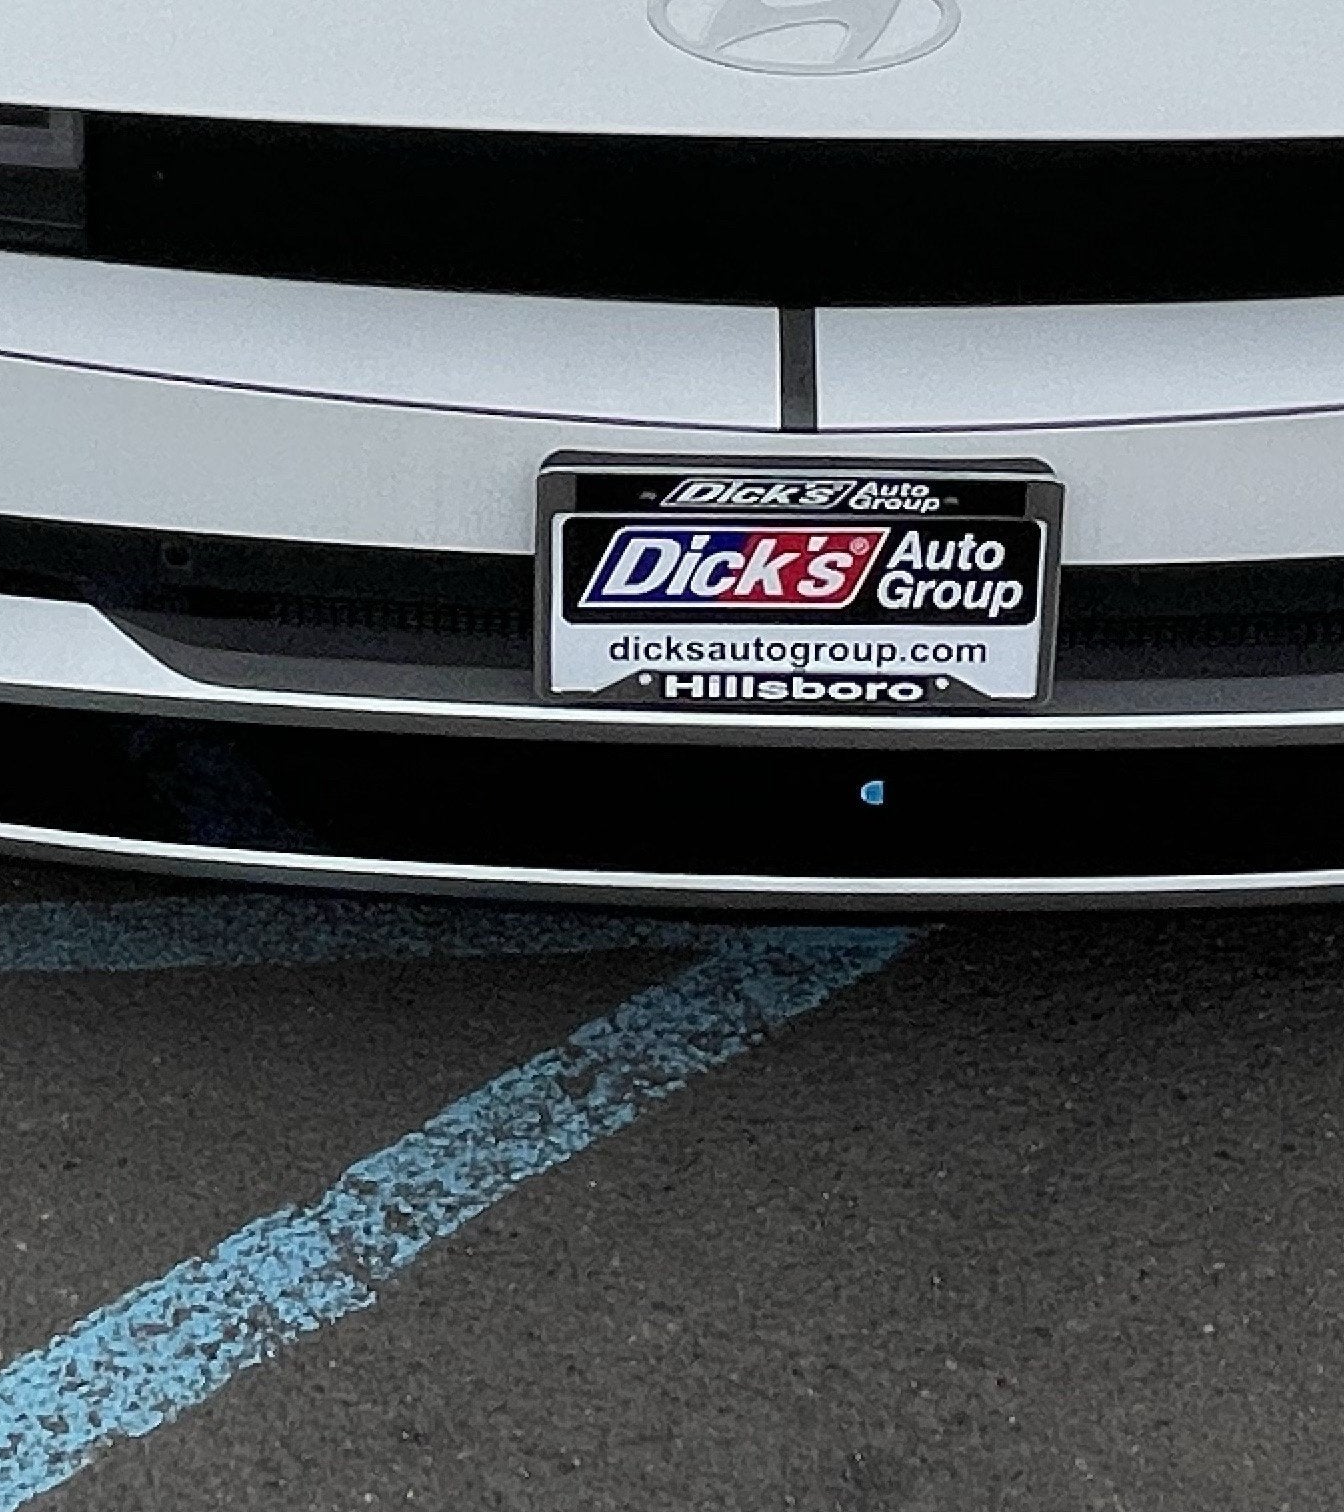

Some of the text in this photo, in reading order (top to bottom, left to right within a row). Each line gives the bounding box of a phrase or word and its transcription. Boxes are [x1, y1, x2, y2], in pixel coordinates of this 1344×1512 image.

[858, 480, 931, 497] Auto
[849, 496, 940, 514] Group
[885, 530, 1006, 571] Auto
[876, 570, 1024, 618] Group
[608, 635, 986, 669] dicksautogroup.com
[665, 674, 924, 702] Hillsboro
